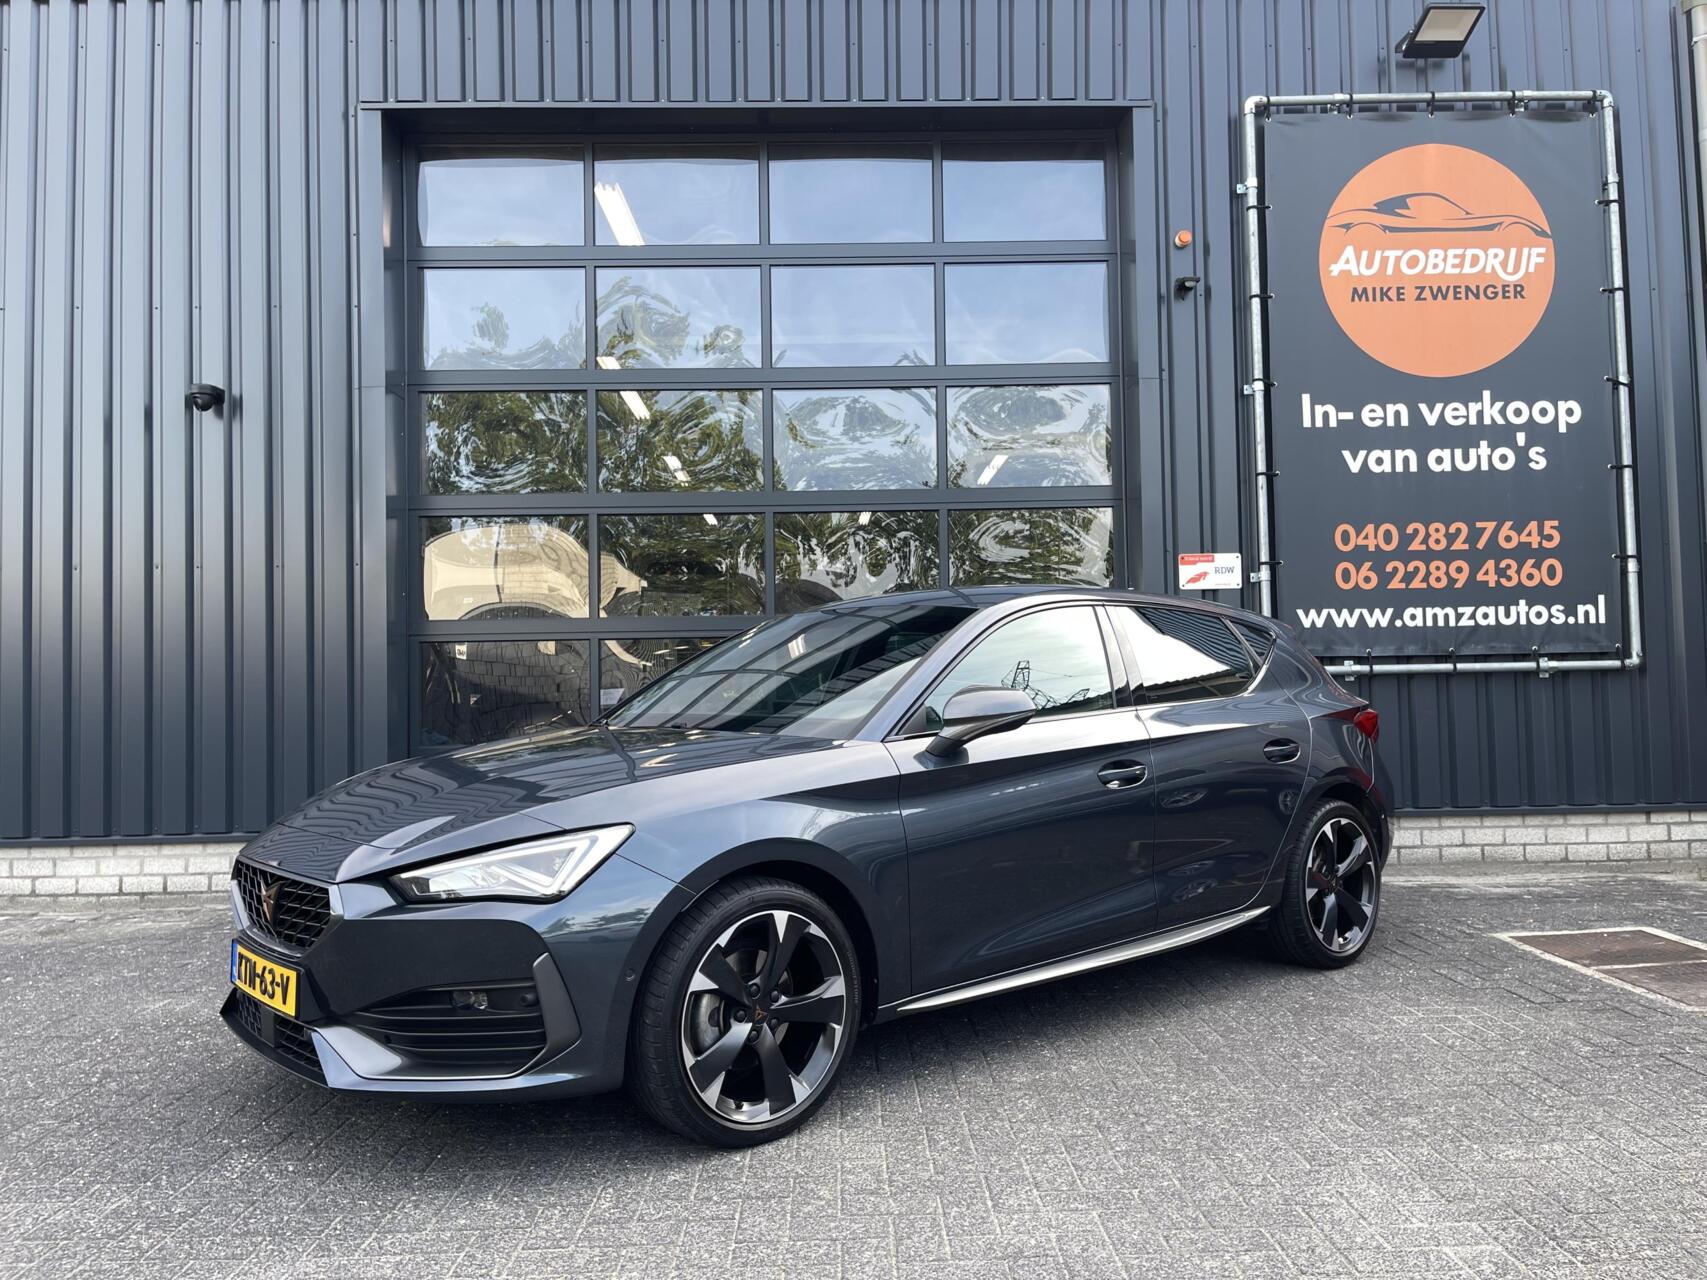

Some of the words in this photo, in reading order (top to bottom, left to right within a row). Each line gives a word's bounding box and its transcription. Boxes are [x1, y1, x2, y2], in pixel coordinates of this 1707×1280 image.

[1329, 245, 1546, 281] AUTOBEDRIJF
[1350, 286, 1406, 303] MIKE
[1415, 283, 1526, 301] ZWENGER
[1301, 393, 1354, 428] In-
[1361, 401, 1409, 427] en
[1418, 390, 1582, 433] verkoop
[1341, 447, 1417, 473] van
[1427, 432, 1547, 472] auto's
[1334, 523, 1399, 552] 040
[1405, 522, 1469, 551] 282
[1475, 520, 1561, 550] 7645
[1214, 566, 1235, 575] RDW
[1334, 561, 1378, 590] 06
[1385, 559, 1469, 589] 2289
[1476, 558, 1563, 588] 4360
[1296, 594, 1606, 628] www.amzautos.nl
